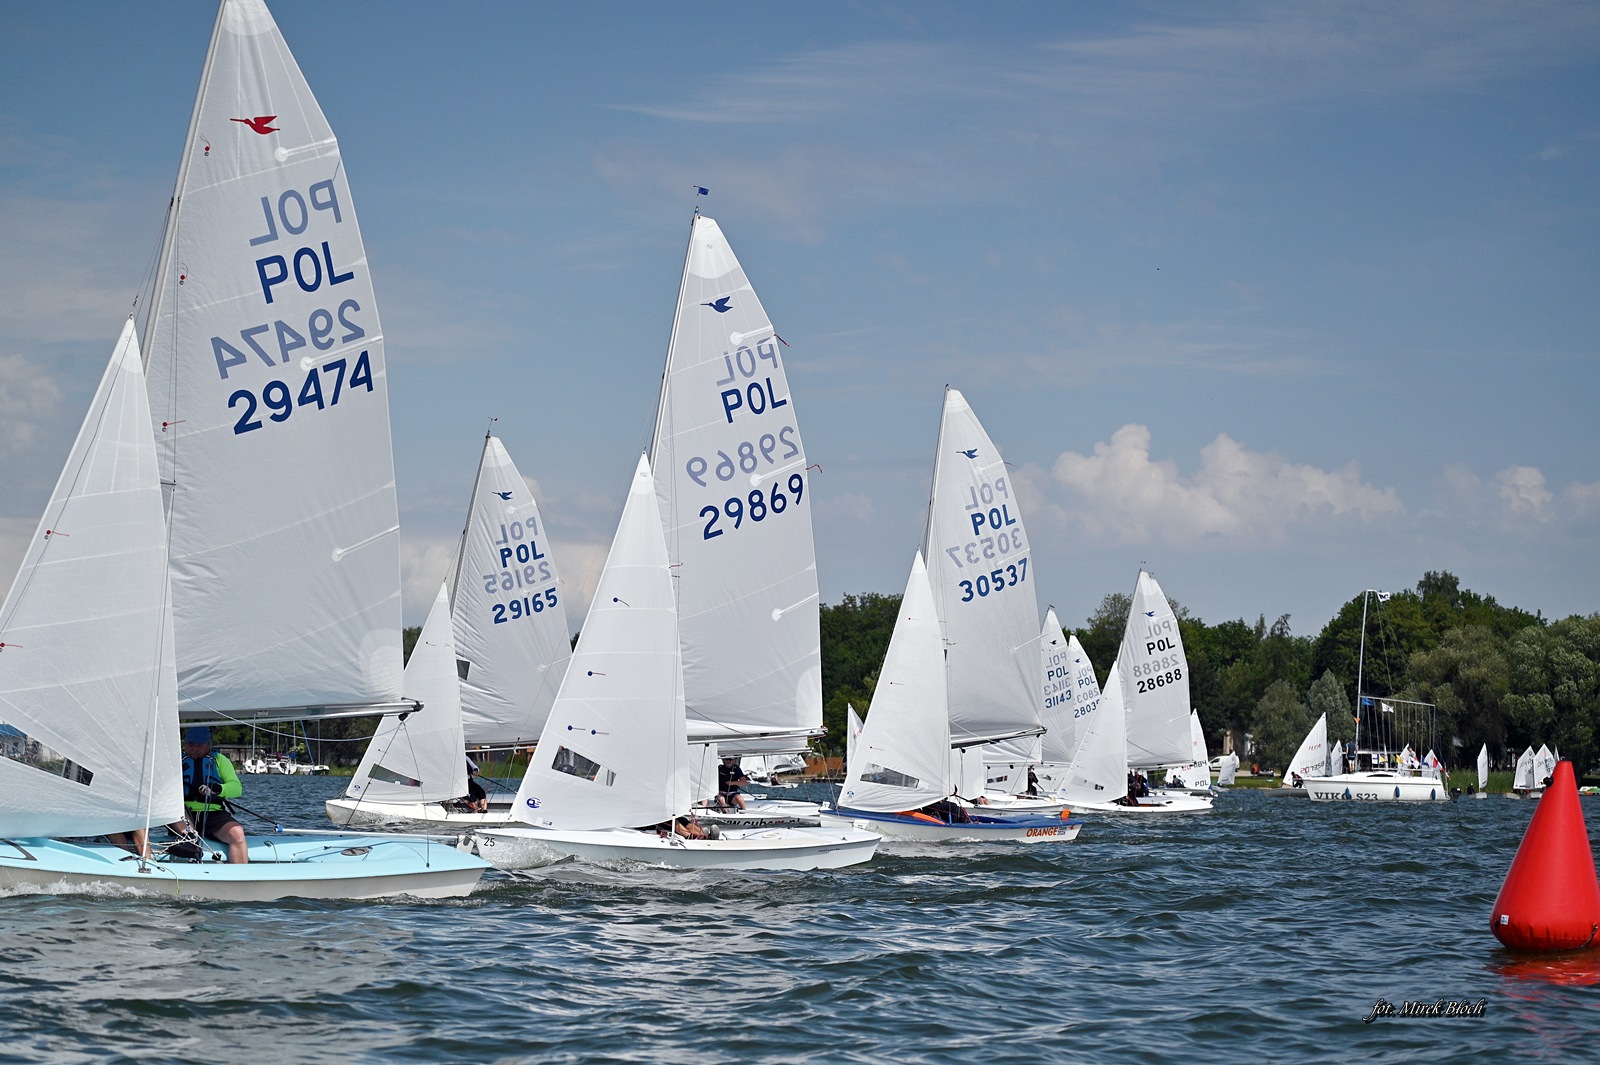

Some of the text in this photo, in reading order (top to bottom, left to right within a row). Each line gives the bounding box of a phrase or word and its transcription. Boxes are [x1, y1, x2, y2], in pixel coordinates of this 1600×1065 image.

[255, 241, 355, 304] POL
[227, 350, 374, 435] 29474
[720, 377, 787, 424] POL
[699, 473, 804, 540] 29869
[970, 504, 1017, 536] POL
[499, 540, 545, 568] POL
[958, 557, 1028, 602] 30537
[491, 587, 558, 624] 29165
[1146, 637, 1176, 655] POL
[1047, 666, 1069, 681] POL
[1078, 675, 1096, 689] POL
[1136, 668, 1182, 693] 28688
[1045, 689, 1072, 709] 31143
[1194, 780, 1209, 788] POL
[1356, 792, 1379, 801] S23
[483, 836, 495, 848] 25
[1026, 826, 1058, 838] ORANGE
